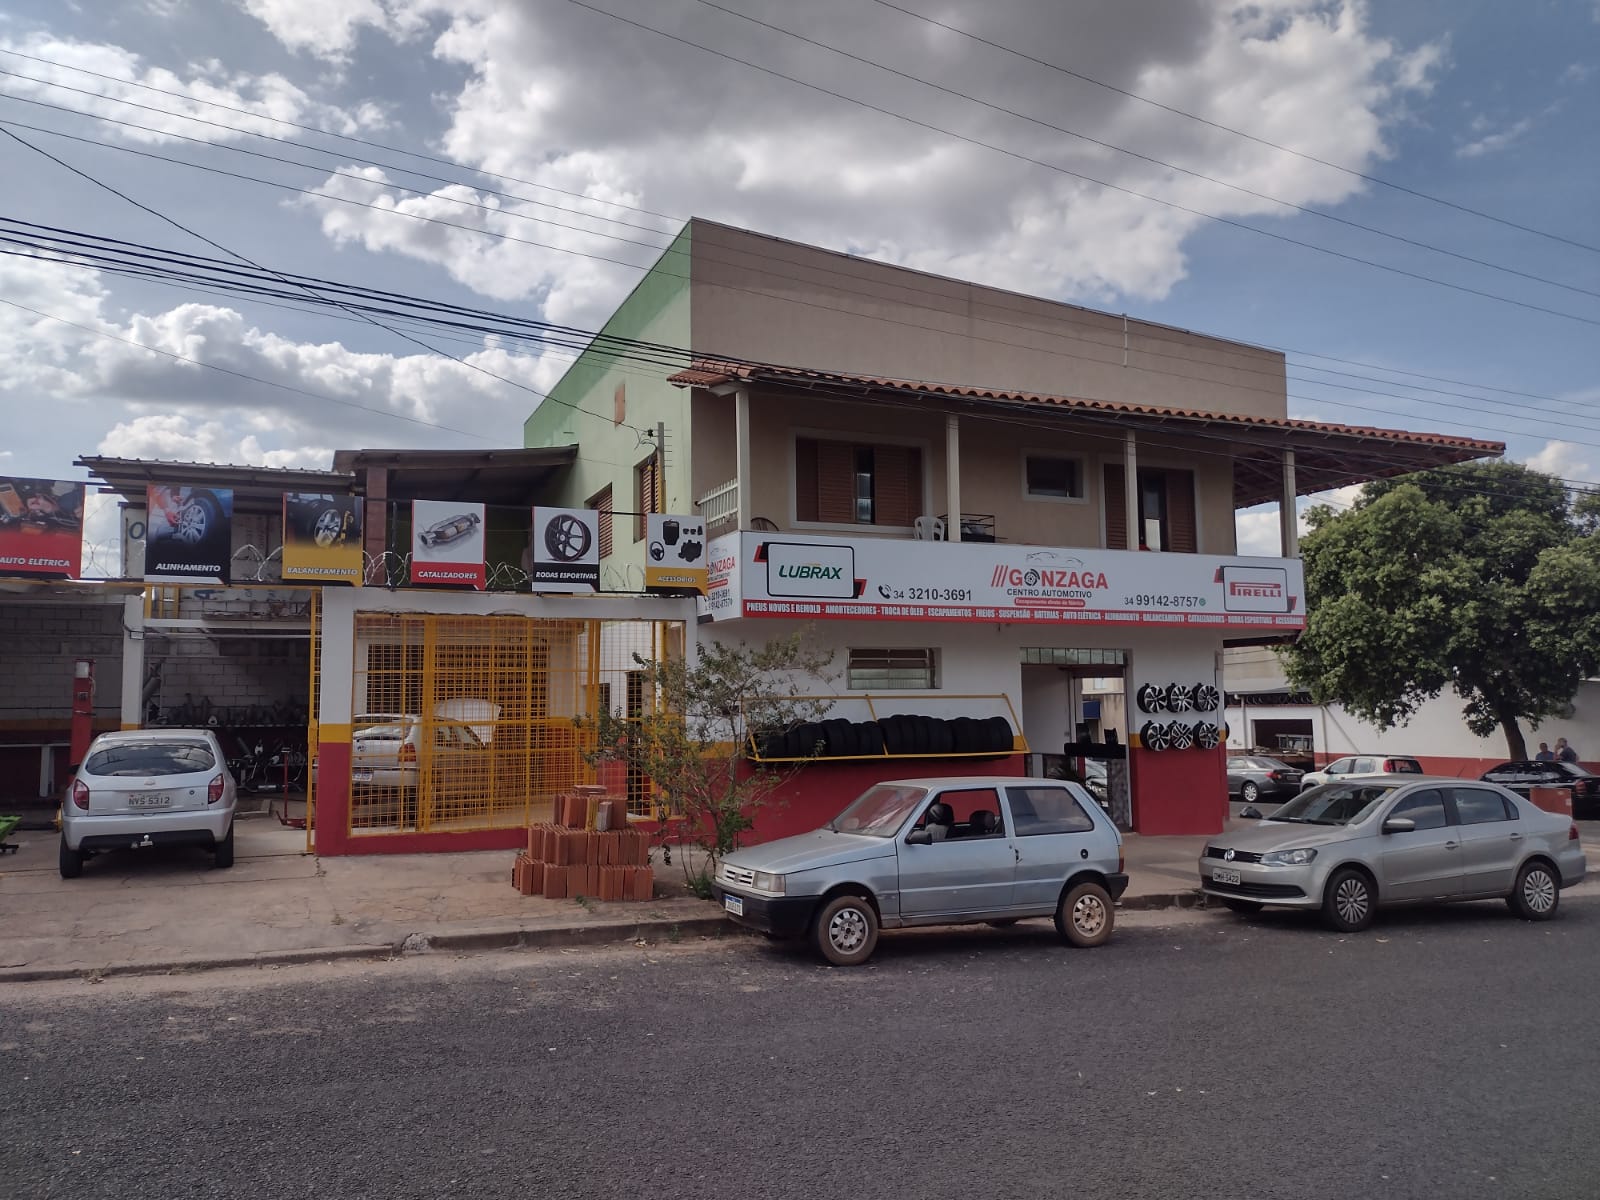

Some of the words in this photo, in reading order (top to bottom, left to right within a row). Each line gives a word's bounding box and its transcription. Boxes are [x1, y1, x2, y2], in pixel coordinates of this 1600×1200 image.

[0, 556, 26, 565] AUTO
[155, 563, 221, 572] ALINHAMENTO
[286, 567, 358, 575] BALANCEAMENTO
[778, 564, 842, 580] LUBRAX
[418, 570, 477, 580] CATALIZADORES
[535, 570, 558, 579] RODAS
[559, 572, 598, 580] ESPORTIVAS
[893, 590, 905, 600] 34
[908, 587, 972, 601] 3210-3691
[1007, 588, 1040, 597] CENTRO
[1041, 589, 1092, 598] AUTOMOTIVO
[1229, 581, 1282, 598] PIRELLI
[1124, 597, 1134, 606] 34
[1136, 594, 1199, 607] 99142-8757
[746, 602, 768, 612] PNEUS
